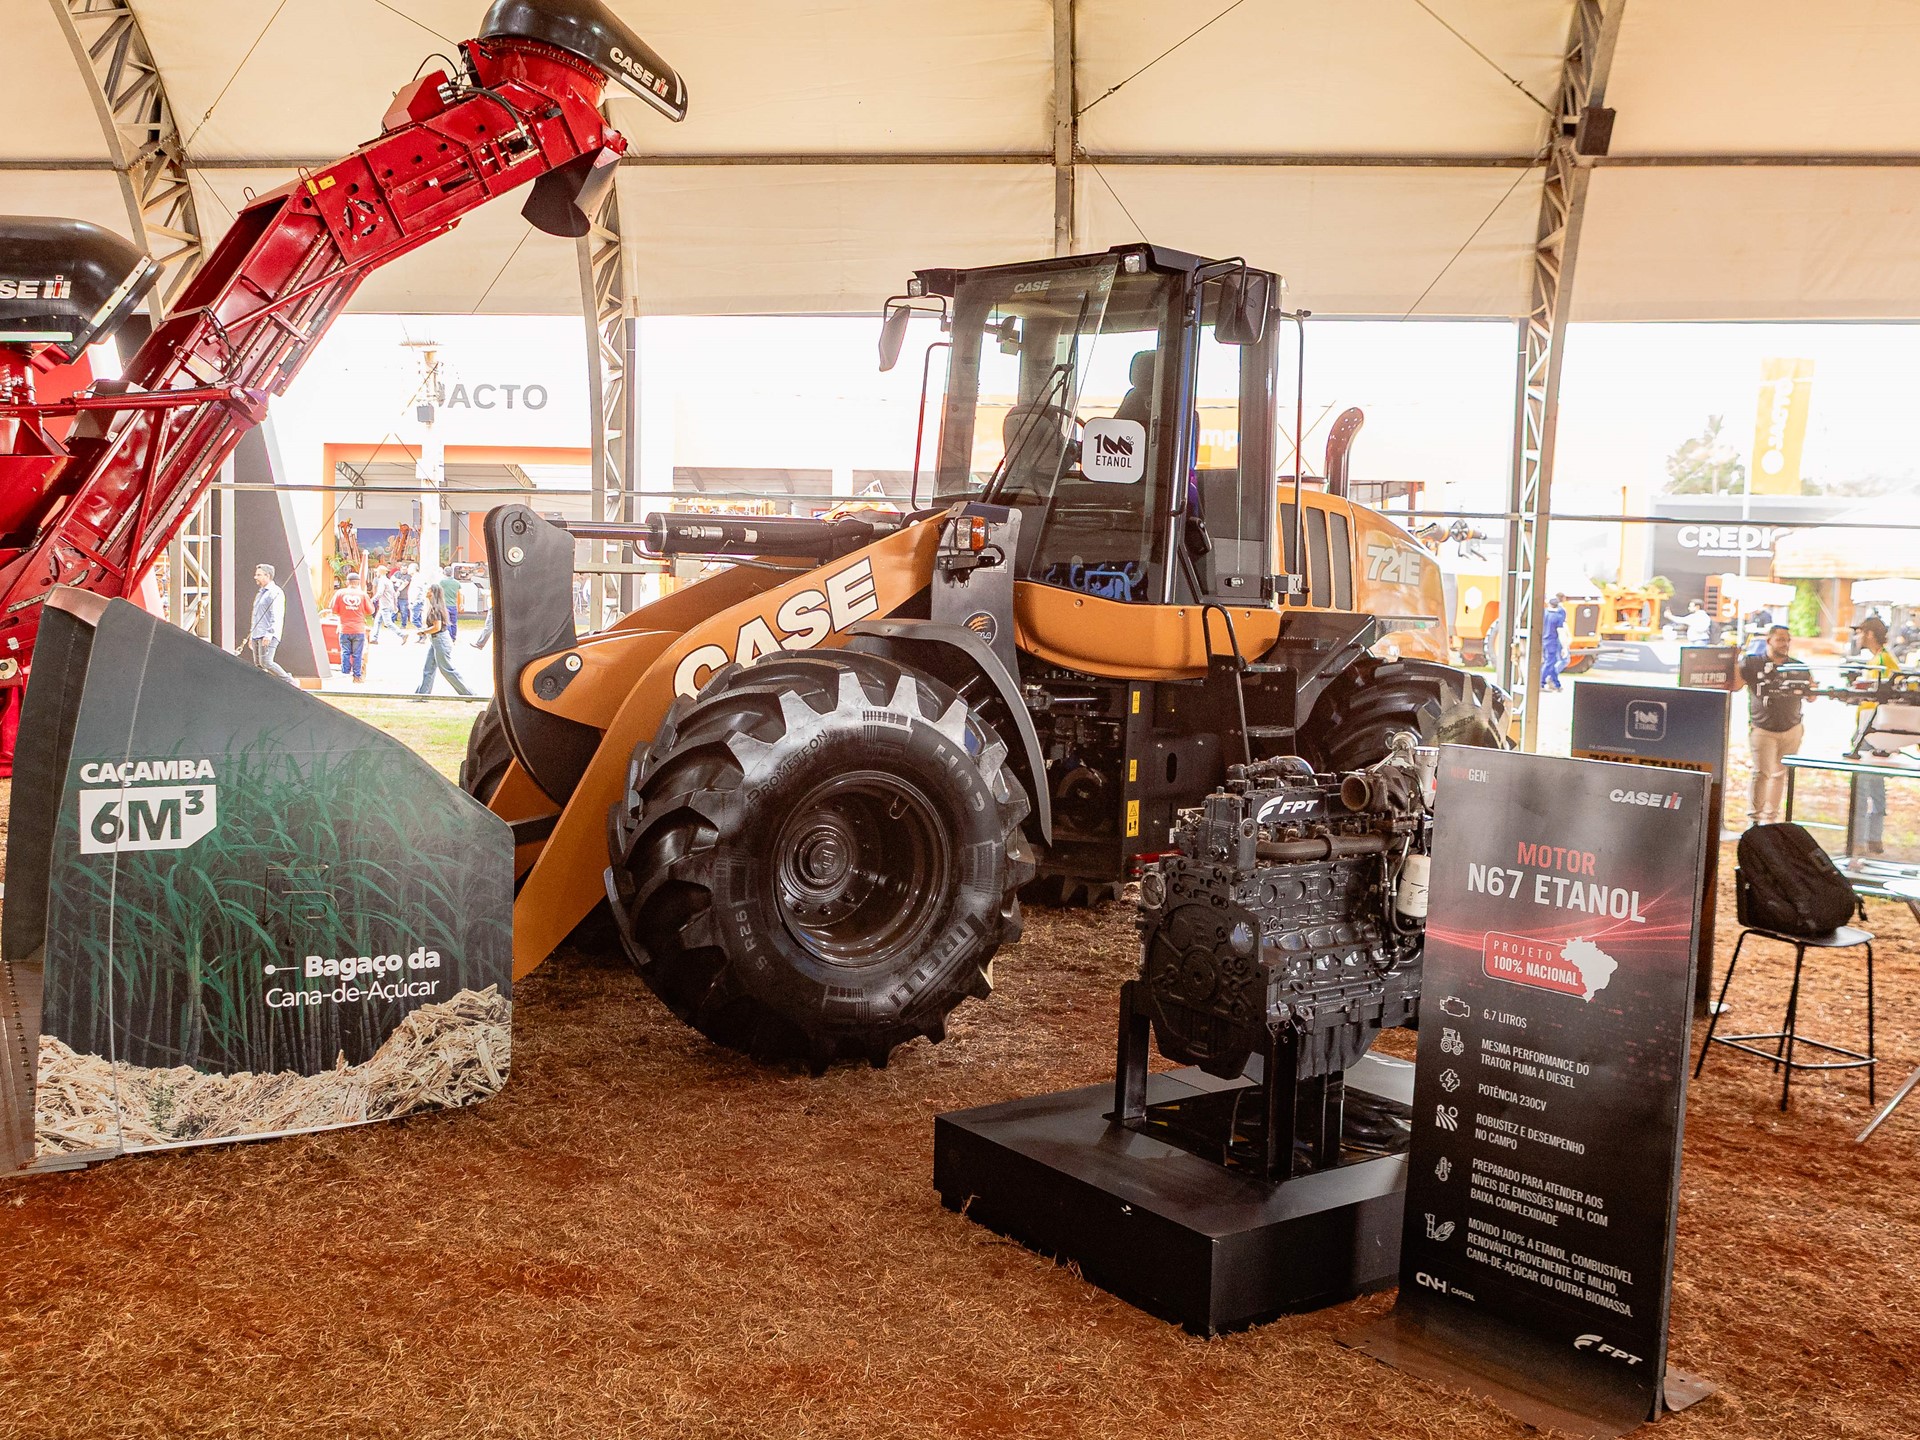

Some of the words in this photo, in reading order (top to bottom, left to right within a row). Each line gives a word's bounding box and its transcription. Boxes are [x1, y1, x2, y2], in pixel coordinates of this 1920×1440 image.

[610, 47, 654, 87] CASE
[1013, 280, 1051, 293] CASE
[1095, 455, 1132, 468] ETANOL
[1367, 544, 1420, 586] 721E
[673, 556, 879, 700] CASE
[80, 759, 216, 787] CAÇAMBA
[1278, 800, 1319, 815] FPT
[1609, 789, 1663, 807] CASE
[1517, 841, 1596, 876] MOTOR
[1467, 862, 1524, 899] N67
[1534, 874, 1646, 923] ETANOL
[305, 954, 403, 982] Bagaço
[407, 947, 441, 969] da
[1494, 940, 1552, 961] PROJETO
[1493, 955, 1523, 974] 100%
[1526, 962, 1579, 987] NACIONAL
[265, 978, 440, 1008] Cana-de-Açúcar
[1483, 1008, 1497, 1020] 6.7
[1498, 1012, 1527, 1028] LITROS
[1480, 1053, 1512, 1071] TRATOR
[1513, 1062, 1537, 1078] PUMA
[1538, 1068, 1545, 1080] A
[1546, 1070, 1576, 1089] DIESEL
[1481, 1038, 1511, 1056] MESMA
[1512, 1046, 1575, 1072] PERFORMANCE
[1576, 1063, 1590, 1076] DO
[1478, 1083, 1518, 1104] POTÊNCIA
[1519, 1094, 1547, 1111] 230CV
[1475, 1128, 1487, 1141] NO
[1488, 1132, 1518, 1150] CAMPO
[1476, 1113, 1519, 1135] ROBUSTEZ
[1520, 1125, 1526, 1137] E
[1527, 1128, 1585, 1155] DESEMPENHO
[1471, 1172, 1498, 1191] NÍVEIS
[1499, 1183, 1511, 1195] DE
[1511, 1186, 1554, 1209] EMISSÕES
[1555, 1200, 1574, 1216] MAR
[1586, 1211, 1609, 1227] COM
[1472, 1158, 1520, 1182] PREPARADO
[1521, 1173, 1543, 1190] PARA
[1544, 1181, 1584, 1203] ATENDER
[1584, 1194, 1604, 1209] AOS
[1470, 1187, 1494, 1205] BAIXA
[1495, 1196, 1559, 1227] COMPLEXIDADE
[1467, 1232, 1513, 1258] RENOVÁVEL
[1514, 1248, 1572, 1279] PROVENIENTE
[1573, 1269, 1586, 1284] DE
[1587, 1274, 1619, 1297] MILHO,
[1468, 1217, 1500, 1238] MOVIDO
[1502, 1229, 1526, 1247] 100%
[1527, 1237, 1534, 1250] A
[1535, 1241, 1569, 1263] ETANOL,
[1571, 1253, 1634, 1285] COMBUSTÍVEL
[1416, 1272, 1447, 1293] CNH
[1451, 1287, 1476, 1301] CAPITAL
[1466, 1247, 1539, 1282] CANA-DE-AÇÚCAR
[1540, 1273, 1553, 1287] OU
[1554, 1279, 1584, 1299] OUTRA
[1585, 1291, 1633, 1318] BIOMASSA.
[1597, 1343, 1643, 1365] FPT
